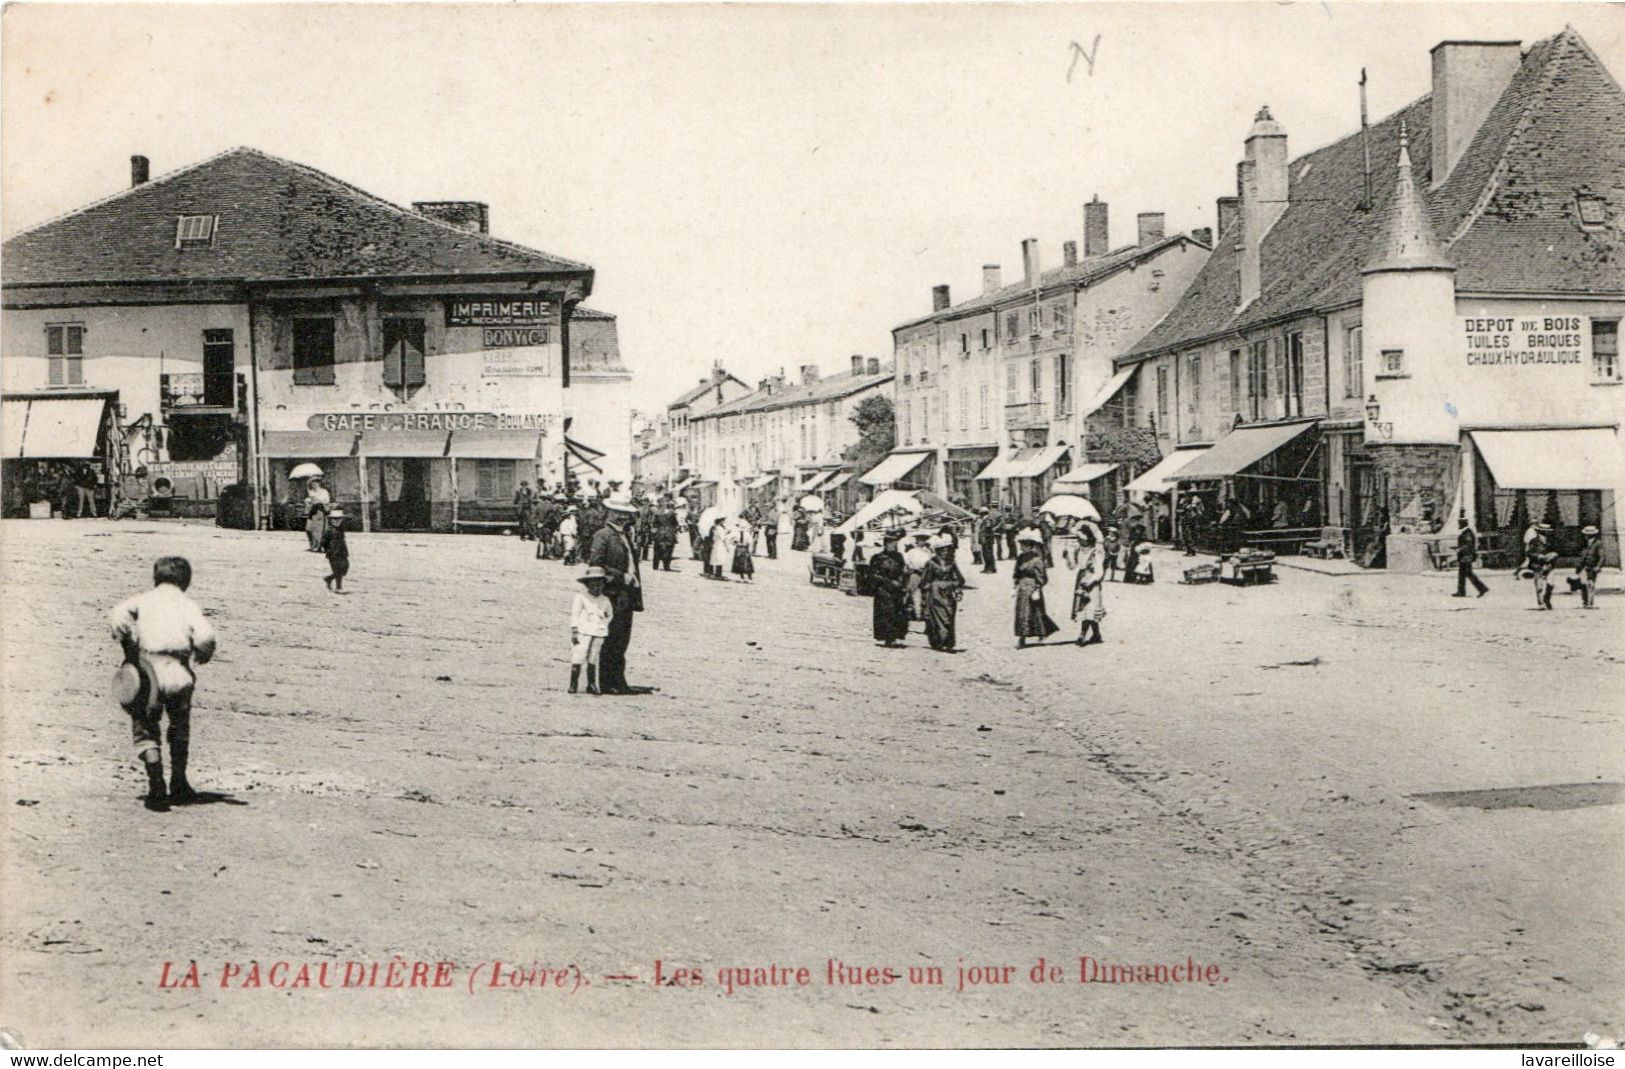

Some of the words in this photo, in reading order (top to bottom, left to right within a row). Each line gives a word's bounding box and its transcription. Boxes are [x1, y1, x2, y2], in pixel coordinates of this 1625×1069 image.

[453, 302, 550, 316] IMPRIMERIE
[1465, 318, 1515, 332] DEPOT
[1521, 321, 1538, 331] DE
[1544, 318, 1581, 331] BOIS
[1466, 335, 1510, 348] TUILES
[1528, 334, 1581, 348] BRIQUES
[403, 413, 486, 431] FRANCE
